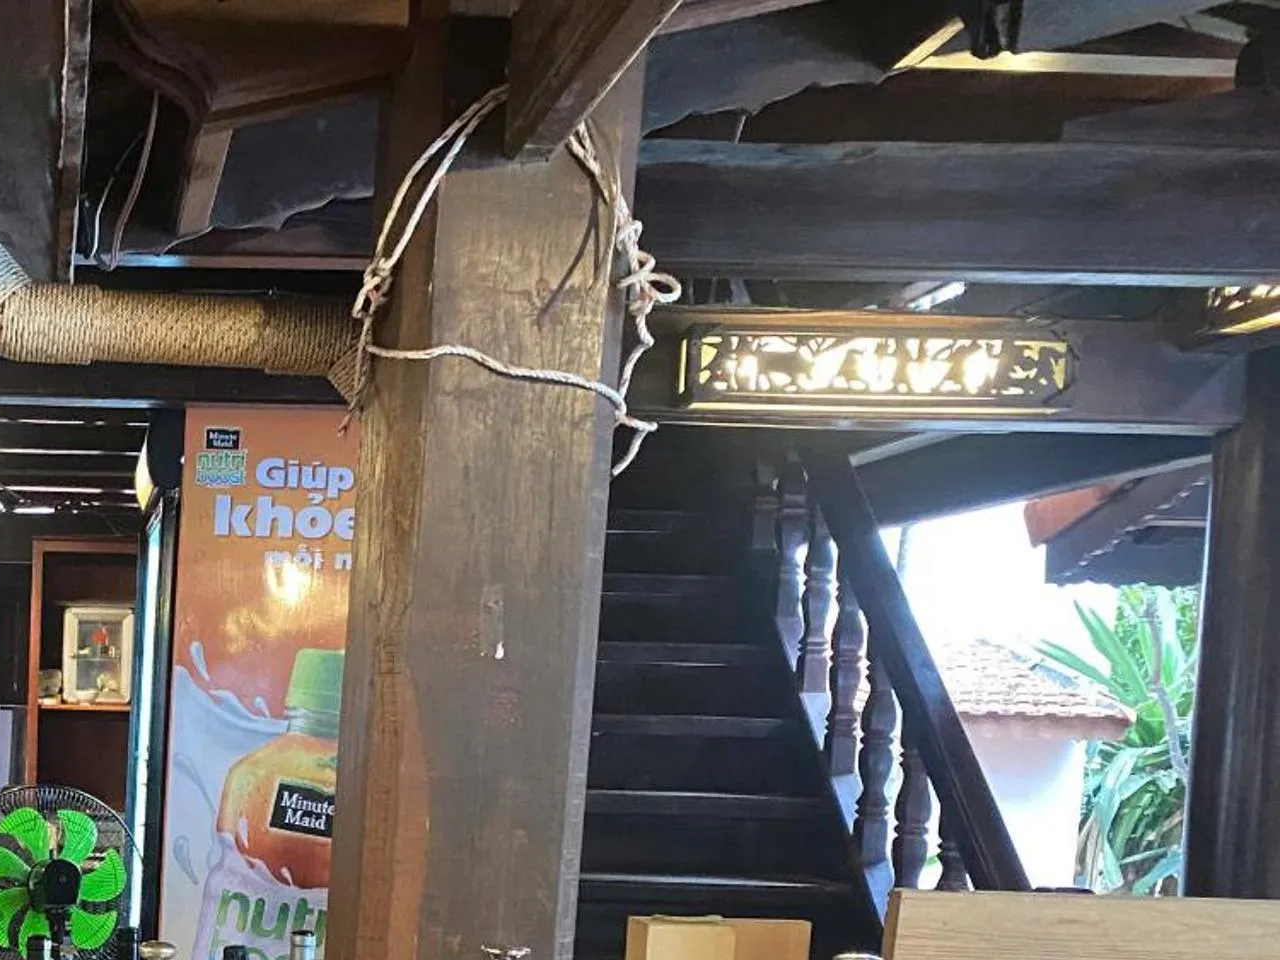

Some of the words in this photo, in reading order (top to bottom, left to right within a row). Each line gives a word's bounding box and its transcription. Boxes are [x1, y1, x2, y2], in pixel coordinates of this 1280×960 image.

[255, 457, 355, 499] Giúp
[280, 790, 336, 816] Minute
[284, 808, 327, 831] Maid
